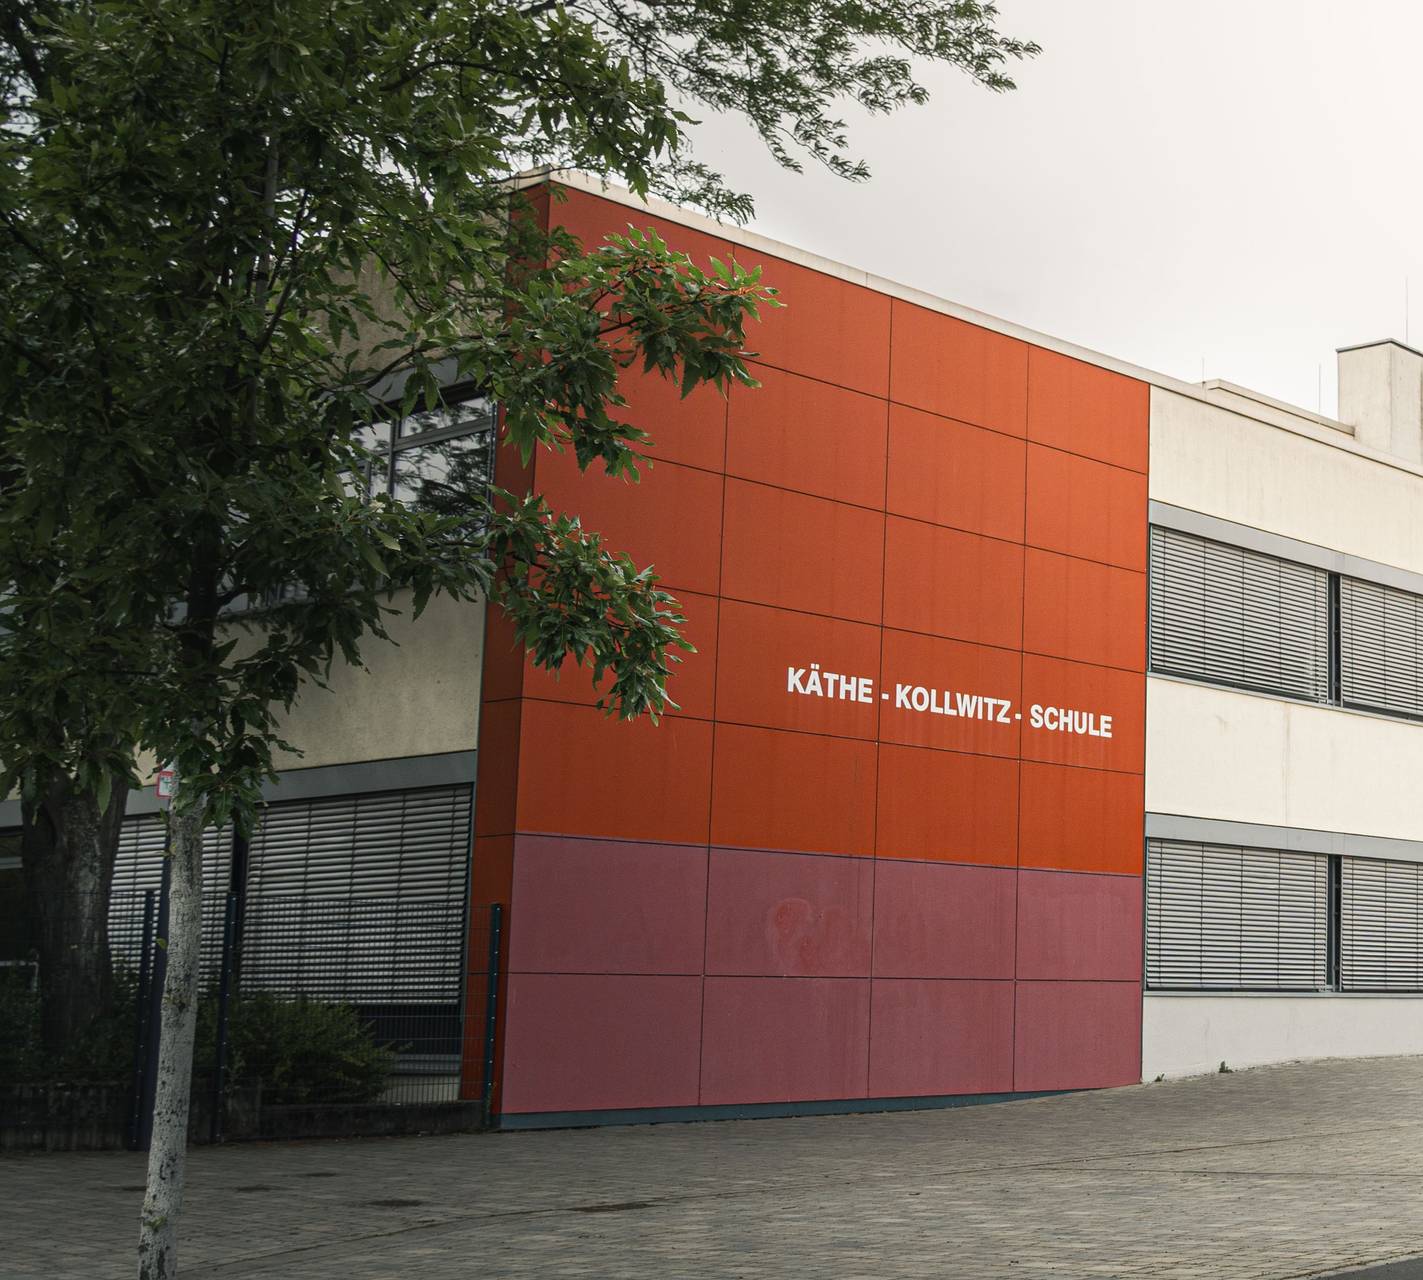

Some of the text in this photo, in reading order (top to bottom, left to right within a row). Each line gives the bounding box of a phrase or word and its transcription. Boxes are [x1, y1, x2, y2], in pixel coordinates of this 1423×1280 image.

[787, 663, 873, 703] KÄTHE
[896, 683, 1012, 723] KOLLWITZ
[1029, 703, 1112, 738] SCHULE
